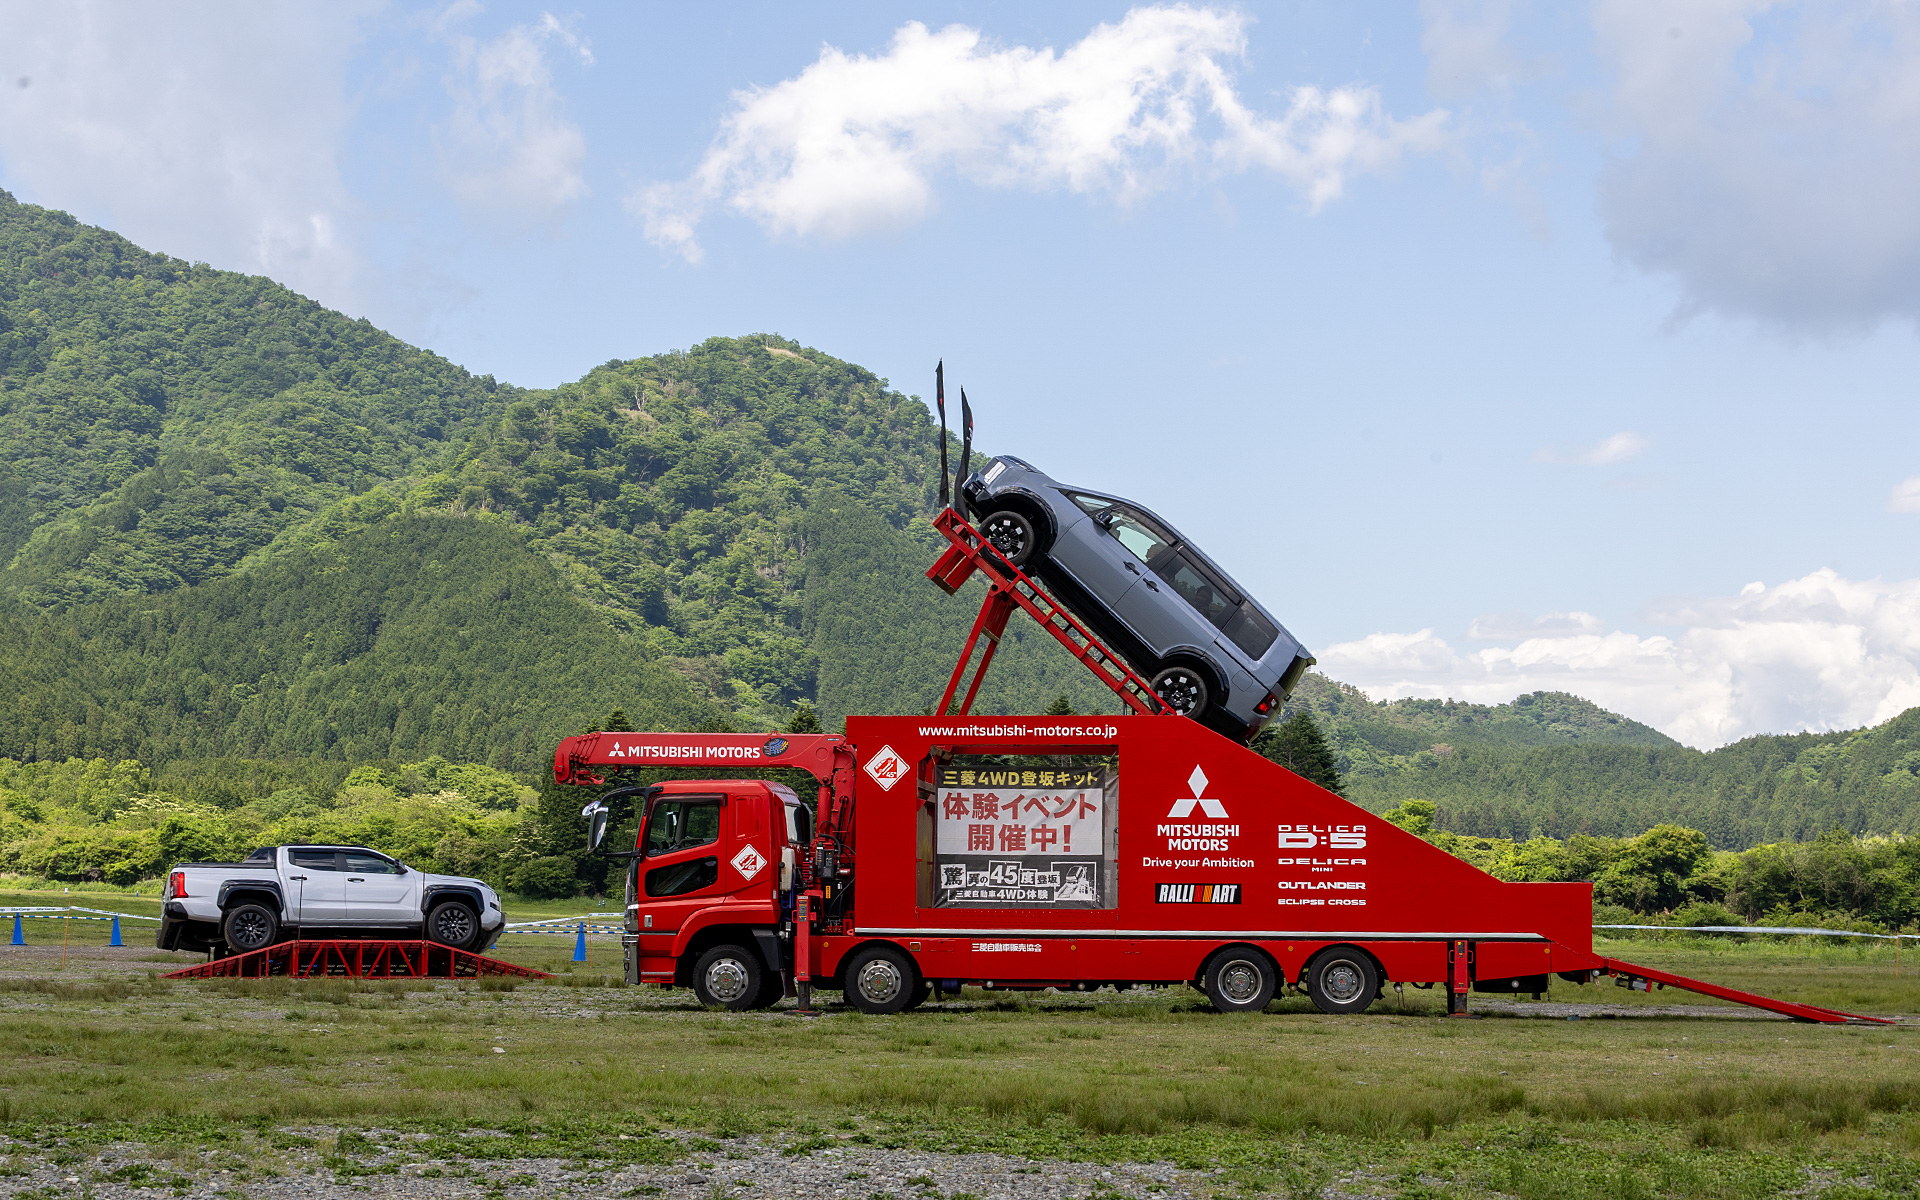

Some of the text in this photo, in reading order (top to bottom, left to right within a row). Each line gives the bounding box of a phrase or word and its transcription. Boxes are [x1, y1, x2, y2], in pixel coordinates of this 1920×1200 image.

[918, 723, 1118, 740] www.mitsubishi-motors.co.jp
[628, 746, 703, 758] MITSUBISHI
[706, 746, 761, 759] MOTORS
[943, 770, 1098, 787] 三菱4WD登坂キット
[942, 792, 1097, 820] 体験イベント
[1157, 824, 1240, 837] MITSUBISHI
[1168, 838, 1229, 851] MOTORS
[1278, 832, 1366, 849] D:5
[1143, 857, 1255, 869] Drive your Ambition
[1278, 881, 1366, 889] OUTLANDER
[956, 890, 1049, 900] 三菱自動車4WD体験
